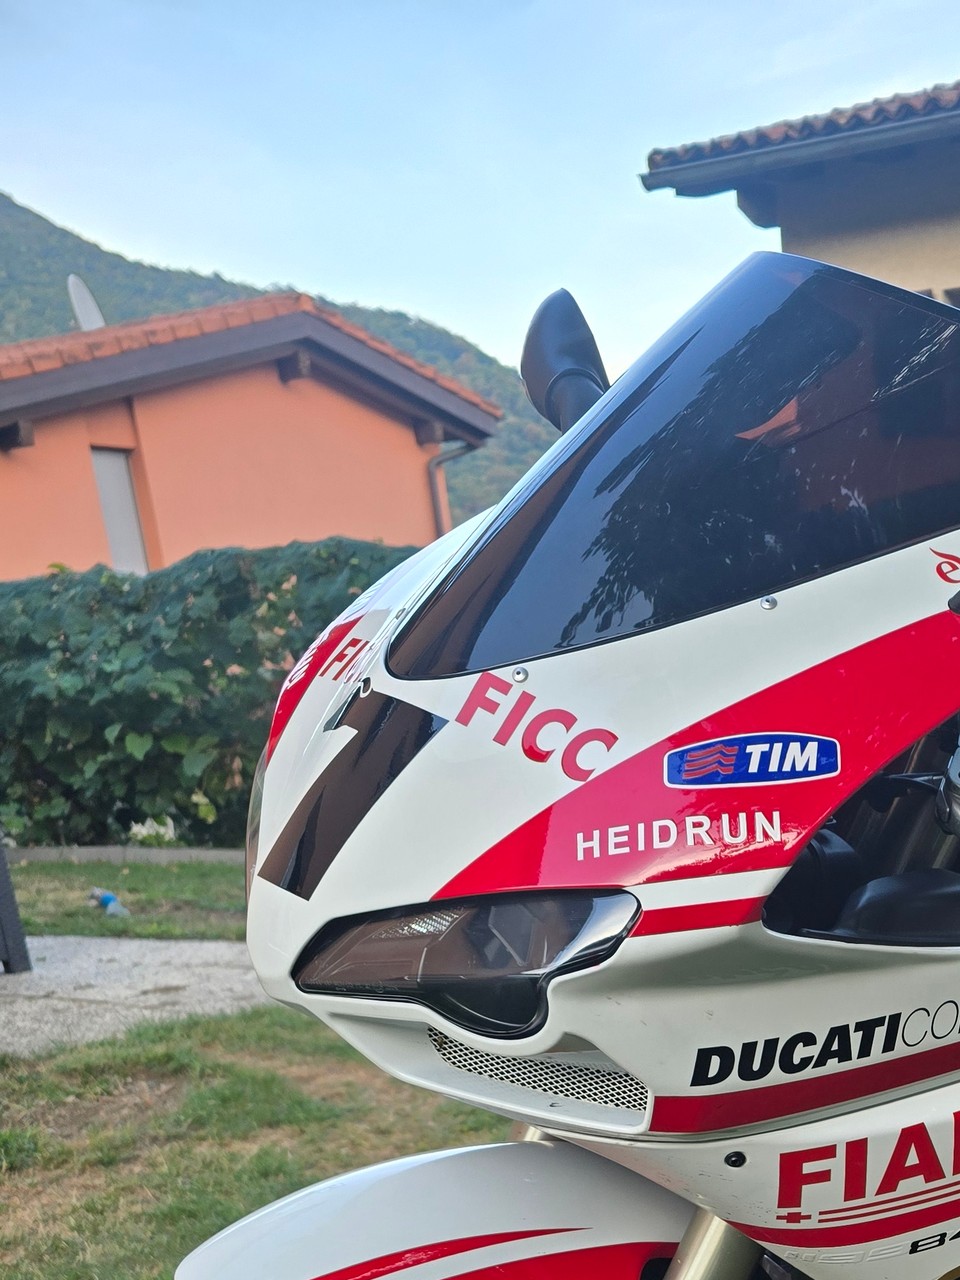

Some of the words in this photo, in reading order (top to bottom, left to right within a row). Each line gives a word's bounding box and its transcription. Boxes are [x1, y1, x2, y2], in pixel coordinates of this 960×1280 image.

[455, 671, 619, 783] FICC
[745, 741, 819, 774] TIM
[576, 811, 782, 862] HEIDRUN
